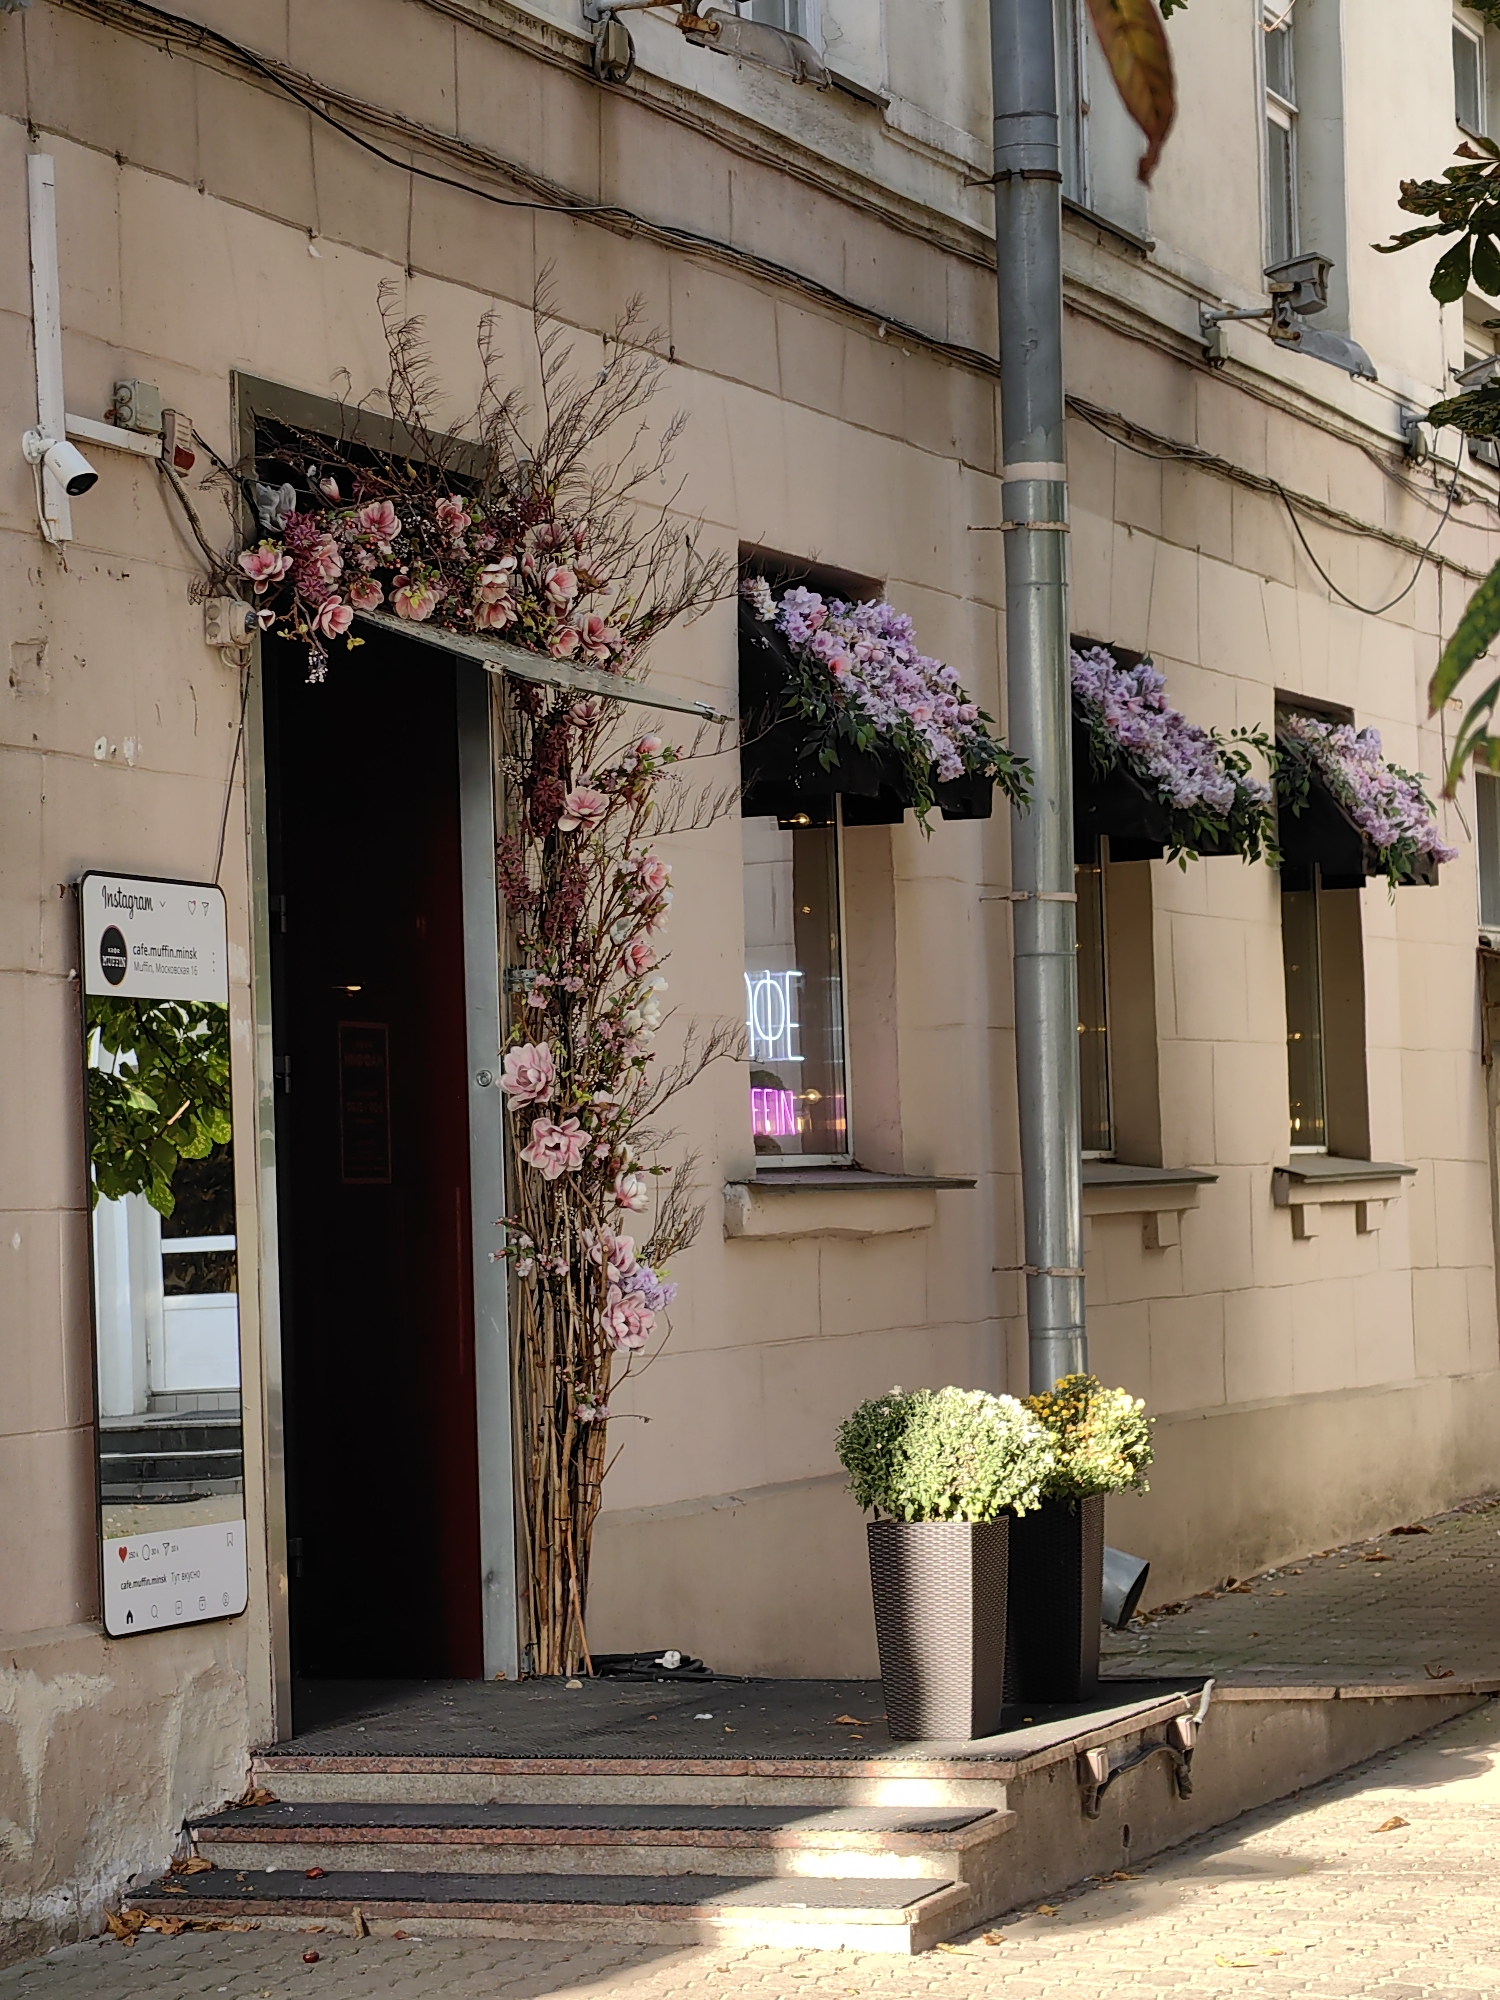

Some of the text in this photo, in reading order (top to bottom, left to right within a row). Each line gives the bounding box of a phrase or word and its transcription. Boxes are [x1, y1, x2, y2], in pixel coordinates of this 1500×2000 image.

[101, 885, 154, 920] Instagram
[132, 942, 198, 960] cafe.muffin.minsk
[120, 1573, 168, 1591] cafe.muffin.minsk
